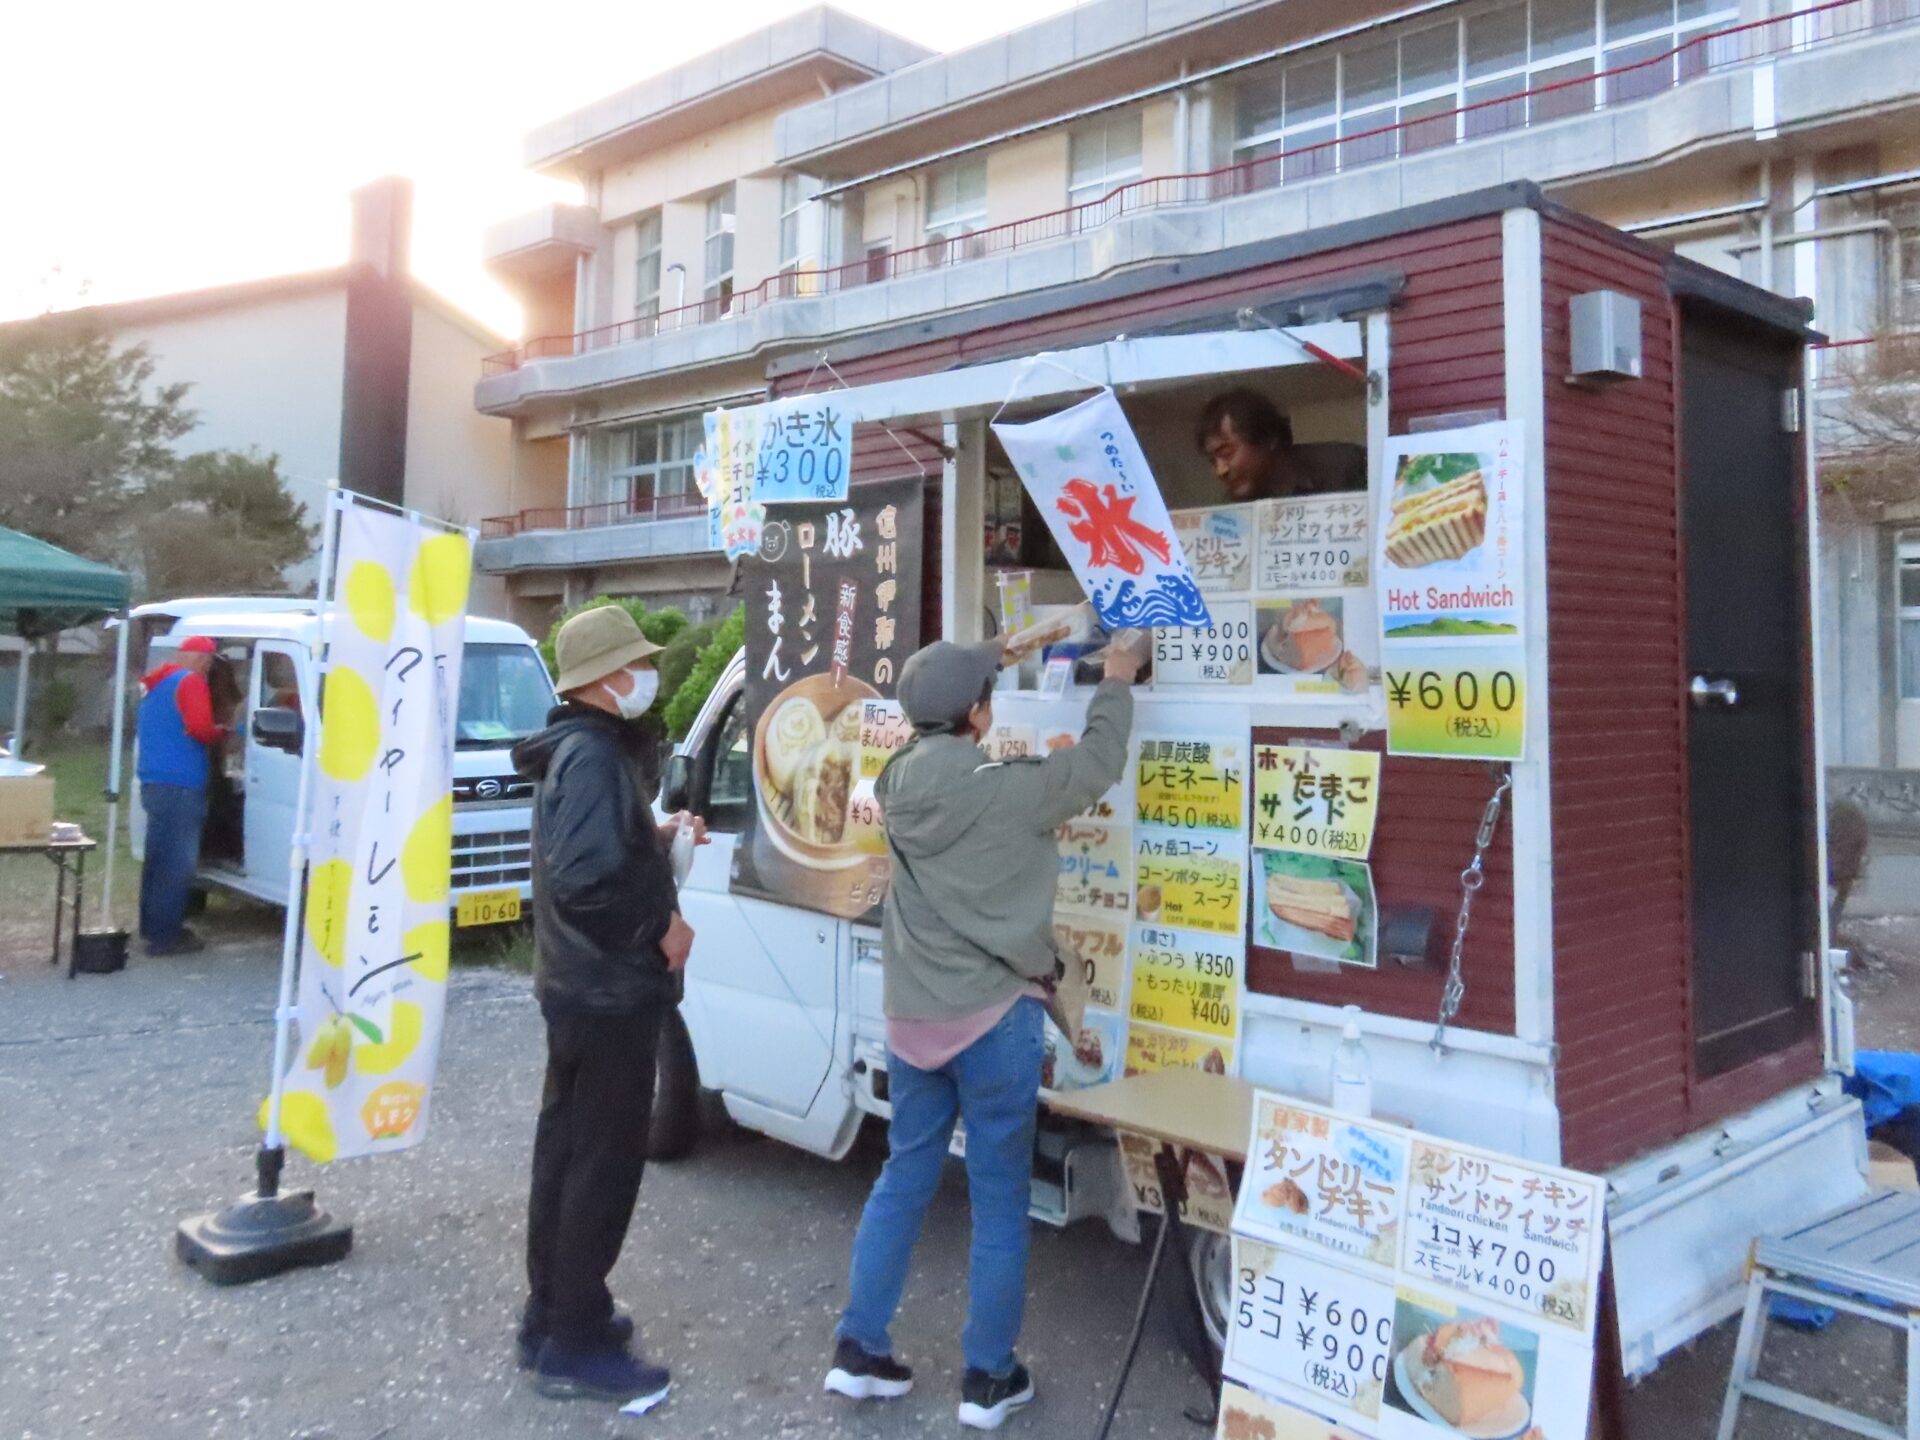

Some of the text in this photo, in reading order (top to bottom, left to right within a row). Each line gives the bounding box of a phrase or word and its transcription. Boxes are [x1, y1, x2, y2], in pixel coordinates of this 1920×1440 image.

[761, 406, 842, 451] かき氷
[756, 447, 843, 487] ¥300
[823, 508, 864, 558] 豚
[1056, 478, 1171, 576] 氷
[1388, 584, 1513, 611] Hot Sandwich
[763, 579, 791, 682] まん
[1386, 670, 1516, 712] ¥600
[1139, 740, 1211, 764] 濃厚炭酸
[1258, 747, 1320, 773] ホット
[1138, 764, 1240, 793] レモネード
[1293, 771, 1371, 804] たまご
[1260, 793, 1345, 826] サンド
[1138, 865, 1239, 891] コーンポタージュ
[1164, 901, 1183, 912] Hot
[1194, 890, 1234, 910] スープ
[1195, 951, 1234, 979] ¥350
[1191, 999, 1231, 1026] ¥400
[1263, 1138, 1396, 1196] タンドリー
[1419, 1150, 1589, 1211] タンドリー チキン
[1318, 1186, 1398, 1232] チキン
[1420, 1197, 1579, 1254] Tandoori chicken Sandwich
[1426, 1177, 1589, 1240] サンドウィッチ
[1299, 1286, 1392, 1347] ¥600
[1304, 1358, 1358, 1400] (税込)
